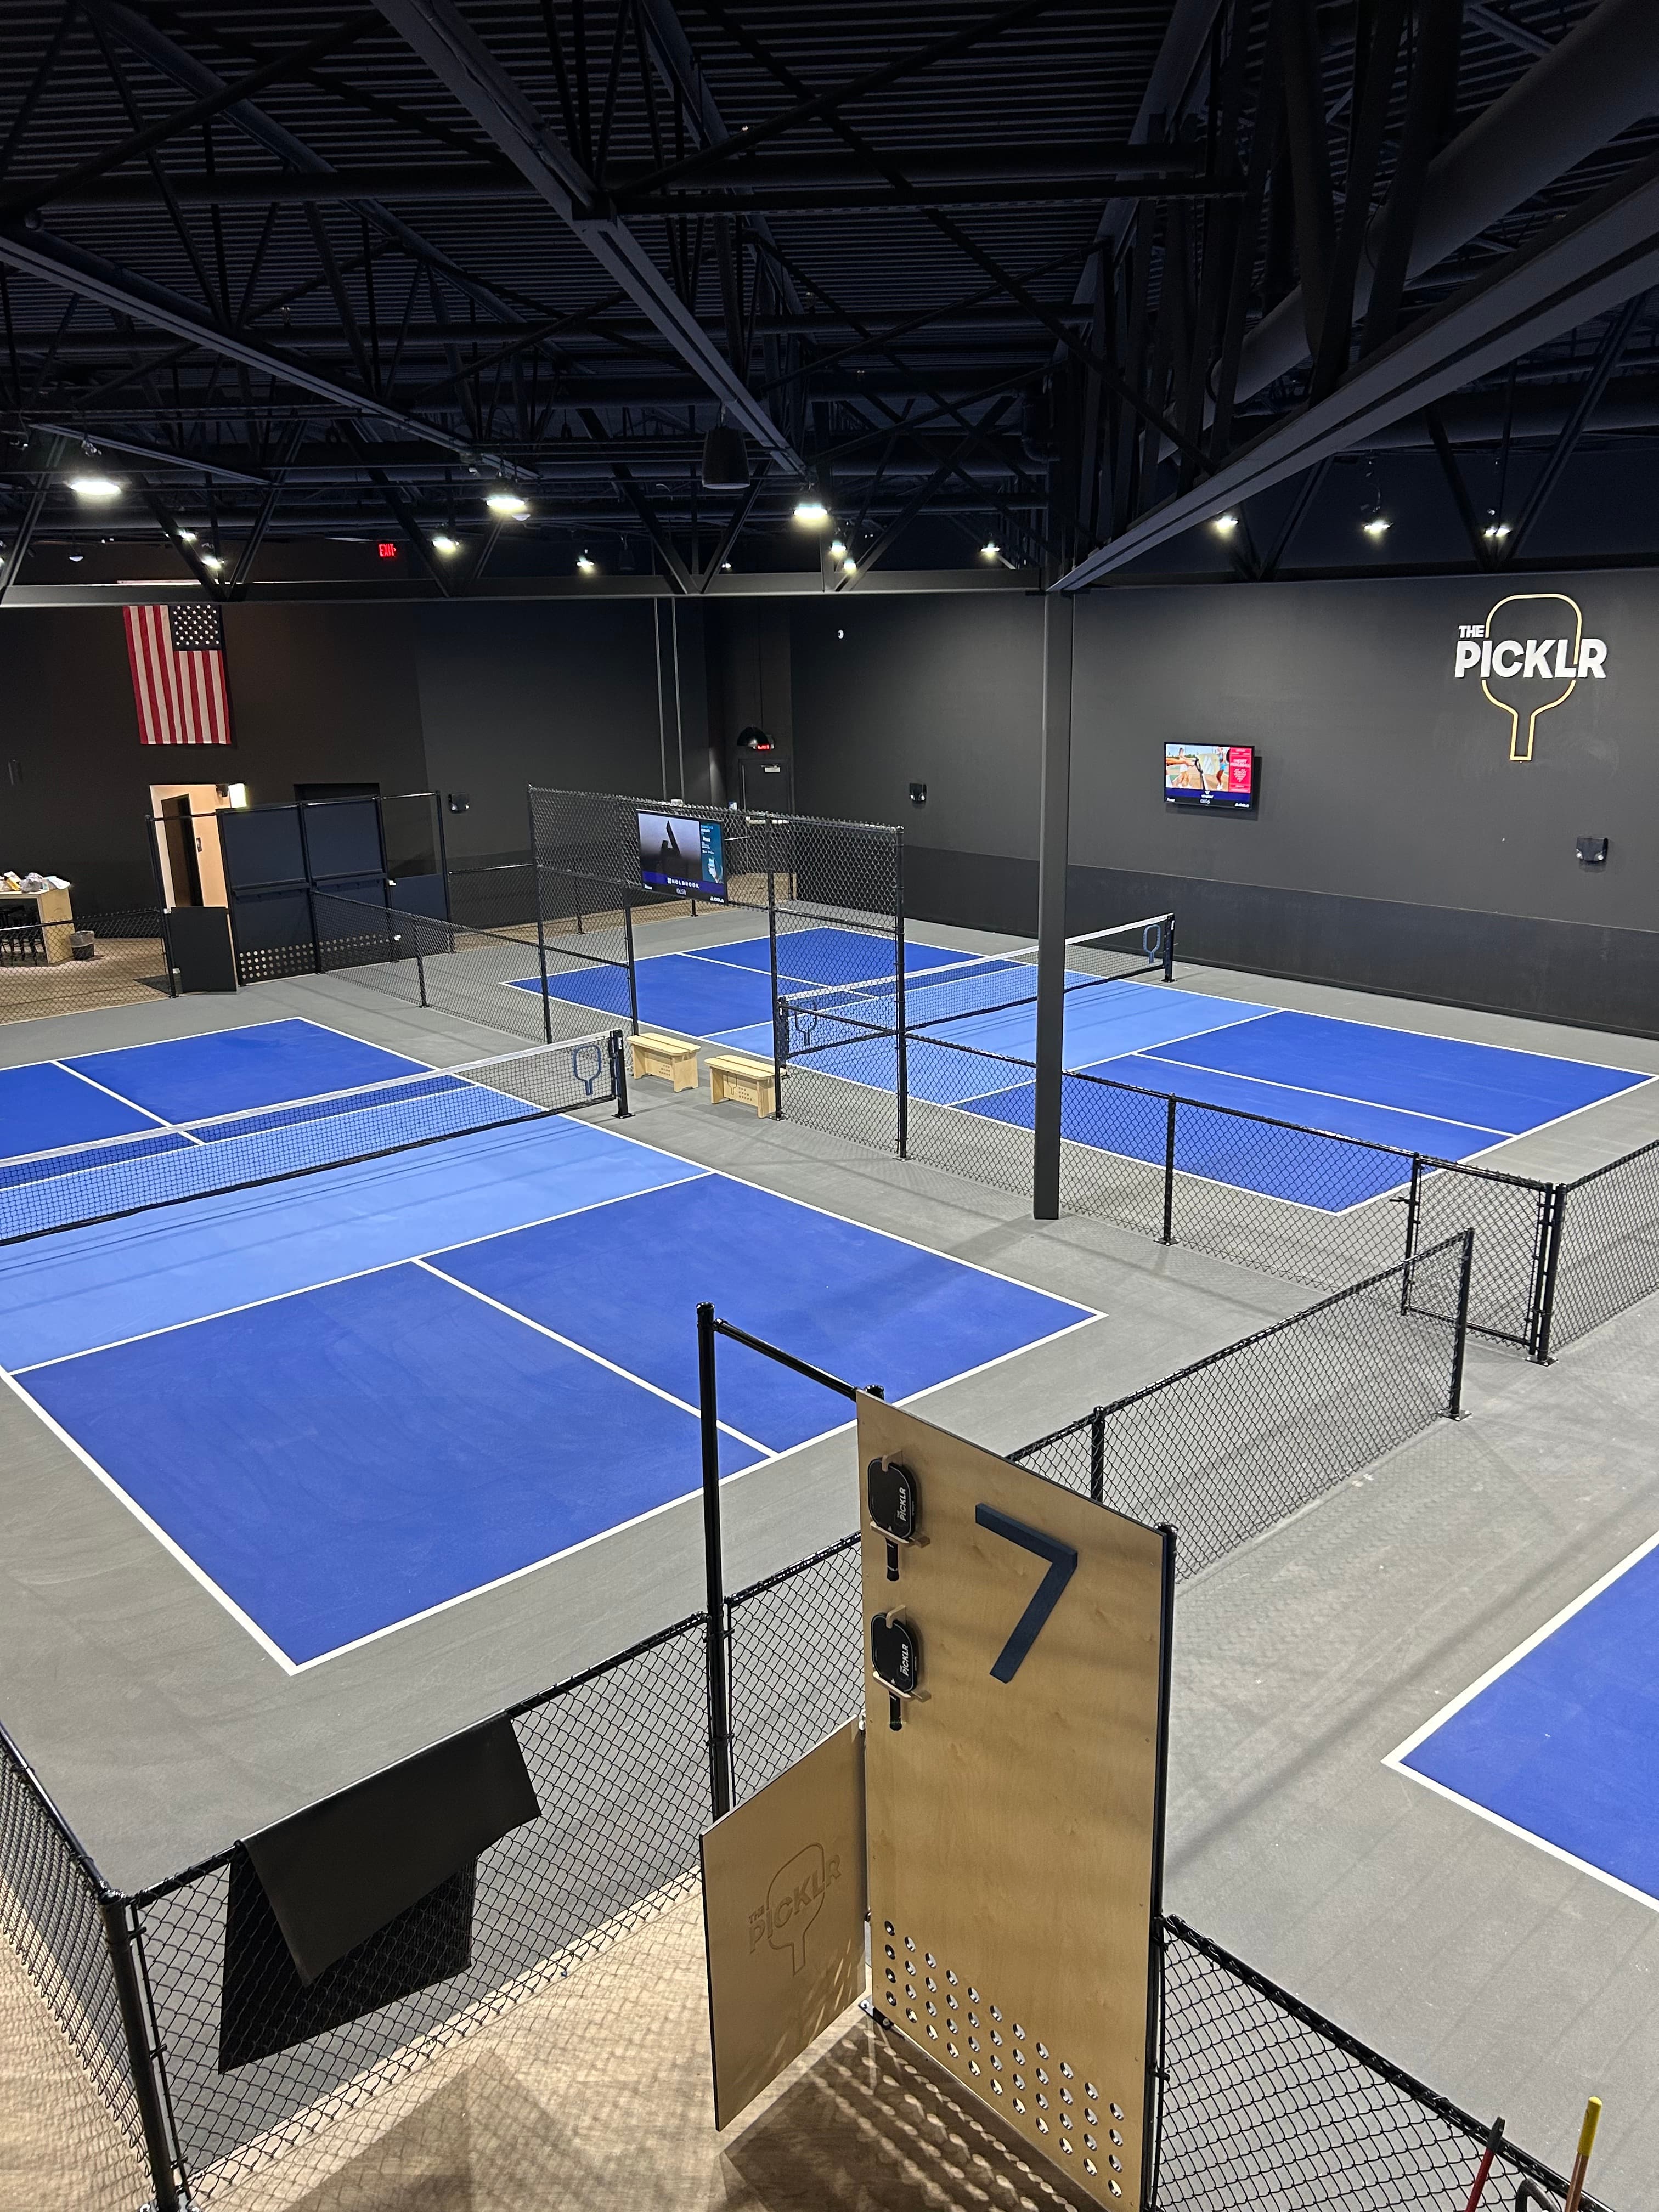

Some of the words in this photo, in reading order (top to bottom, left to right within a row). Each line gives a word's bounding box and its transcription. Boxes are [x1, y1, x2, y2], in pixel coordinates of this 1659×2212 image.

[379, 544, 394, 556] EXIT
[1458, 625, 1485, 639] THE
[1454, 638, 1607, 679] PICKLR
[672, 879, 699, 889] HOLBROOK
[975, 1503, 1078, 1684] 7
[749, 1854, 841, 1954] PICKLR
[748, 1905, 765, 1924] THE
